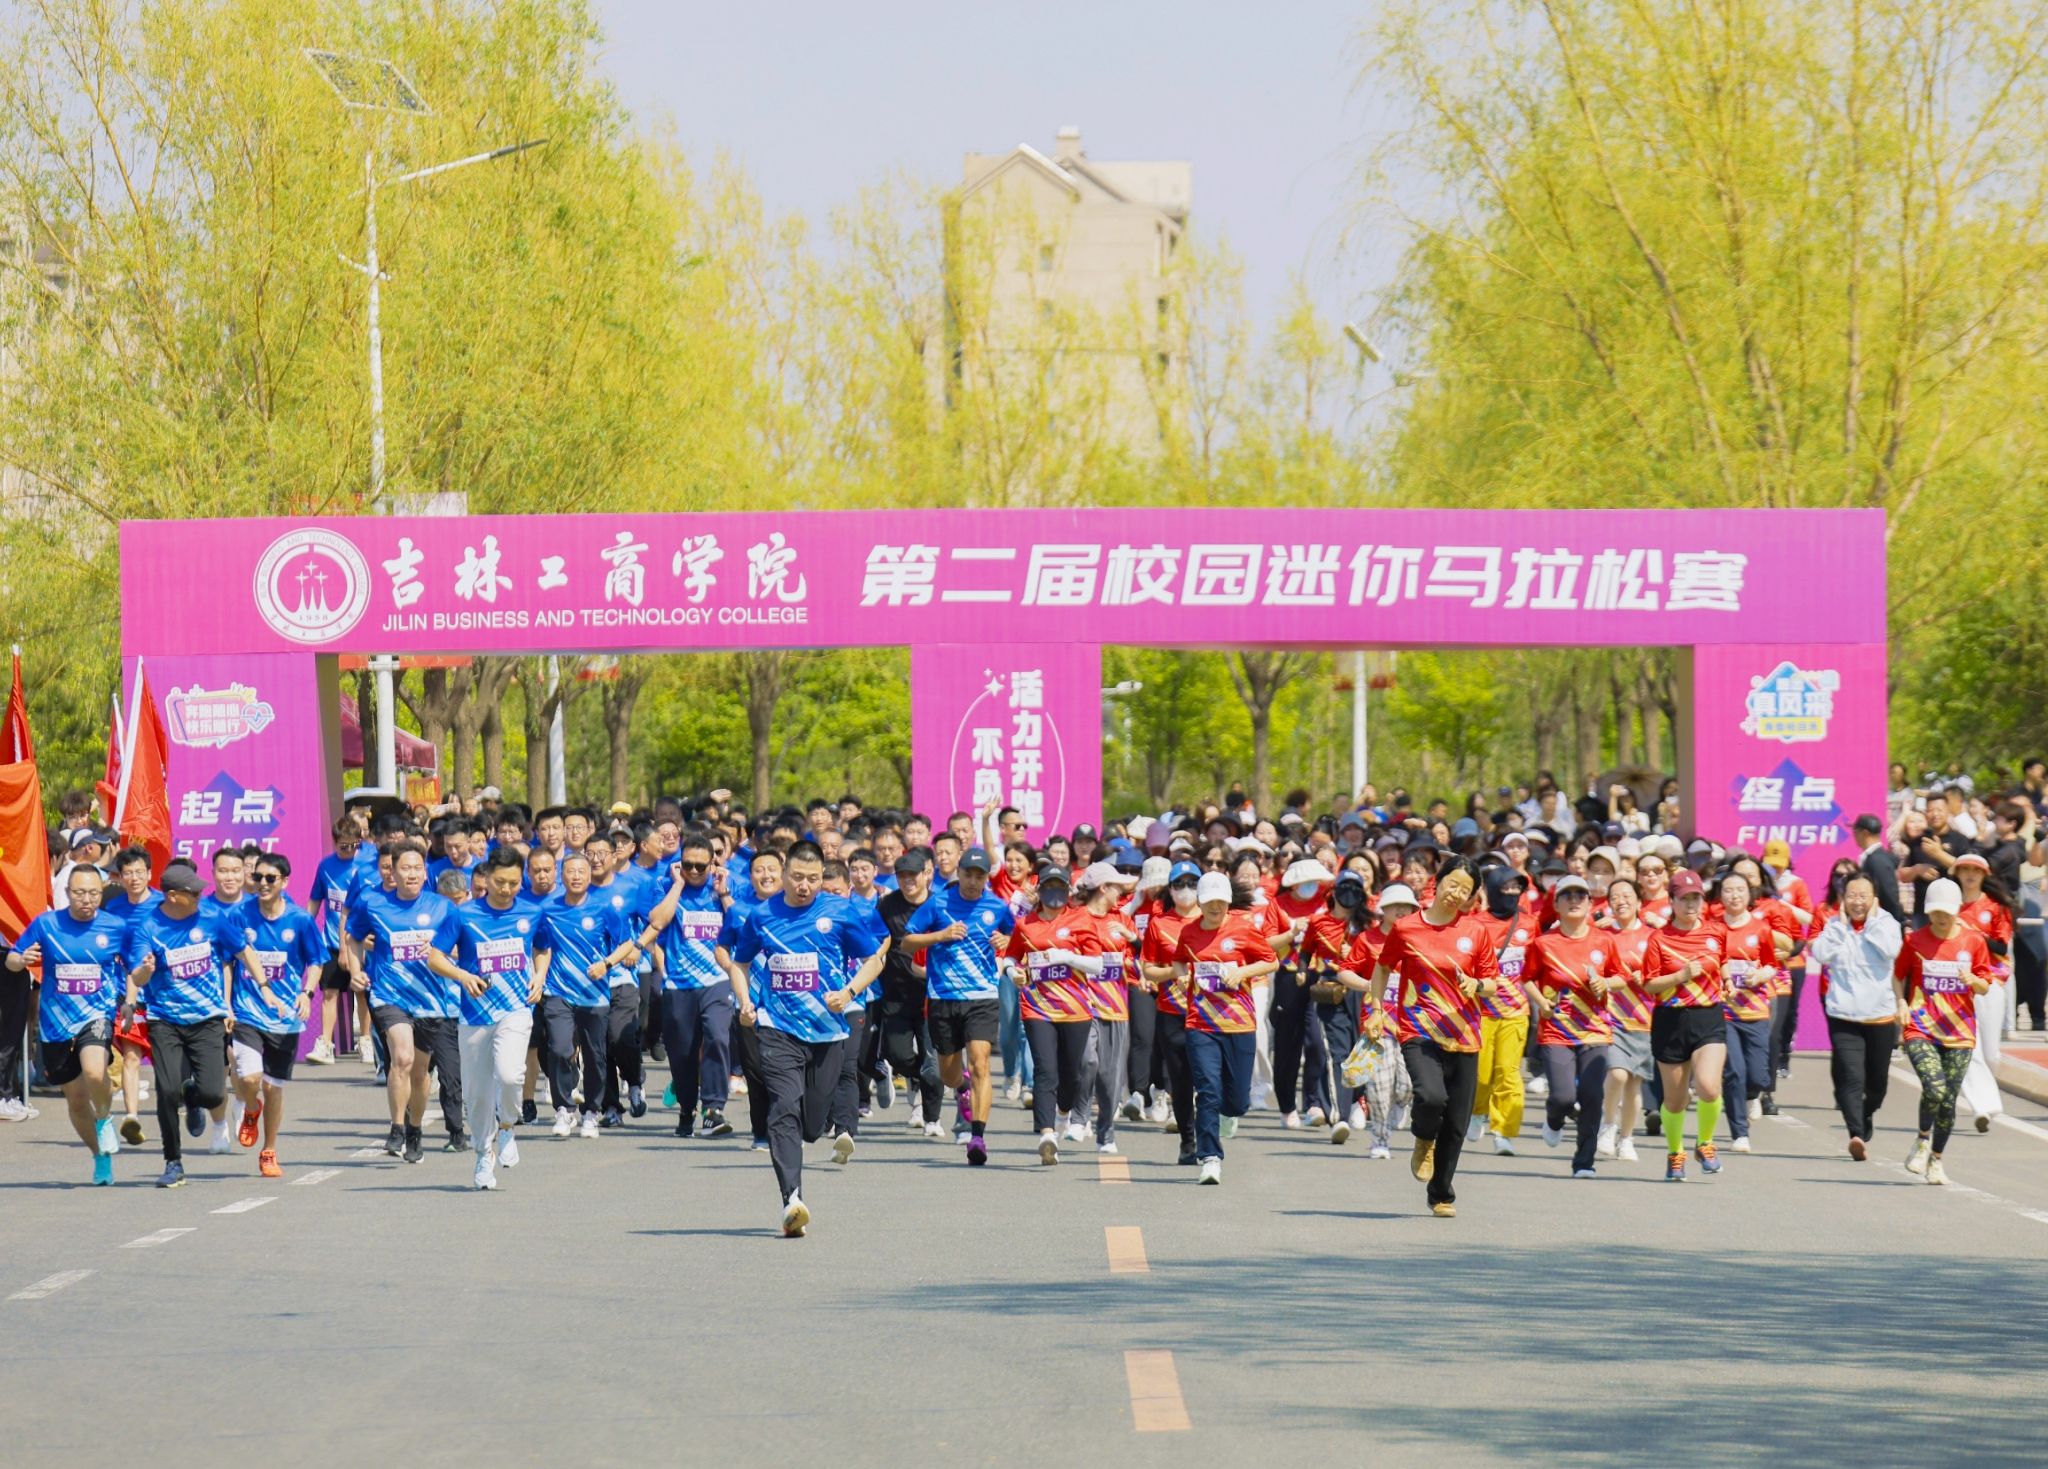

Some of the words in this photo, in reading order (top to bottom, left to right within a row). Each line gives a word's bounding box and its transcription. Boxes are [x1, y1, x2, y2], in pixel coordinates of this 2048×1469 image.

[382, 531, 808, 607] 吉林工商学院
[859, 543, 1749, 611] 第二届校园迷你马拉松赛
[382, 614, 428, 632] JILIN
[433, 610, 530, 630] BUSINESS
[534, 609, 575, 627] AND
[579, 608, 713, 626] TECHNOLOGY
[718, 606, 808, 624] COLLEGE
[1008, 669, 1045, 828] 活力开跑
[178, 789, 274, 826] 起点
[1738, 776, 1836, 811] 终点
[1737, 825, 1838, 844] FINISH
[771, 973, 813, 989] 教243
